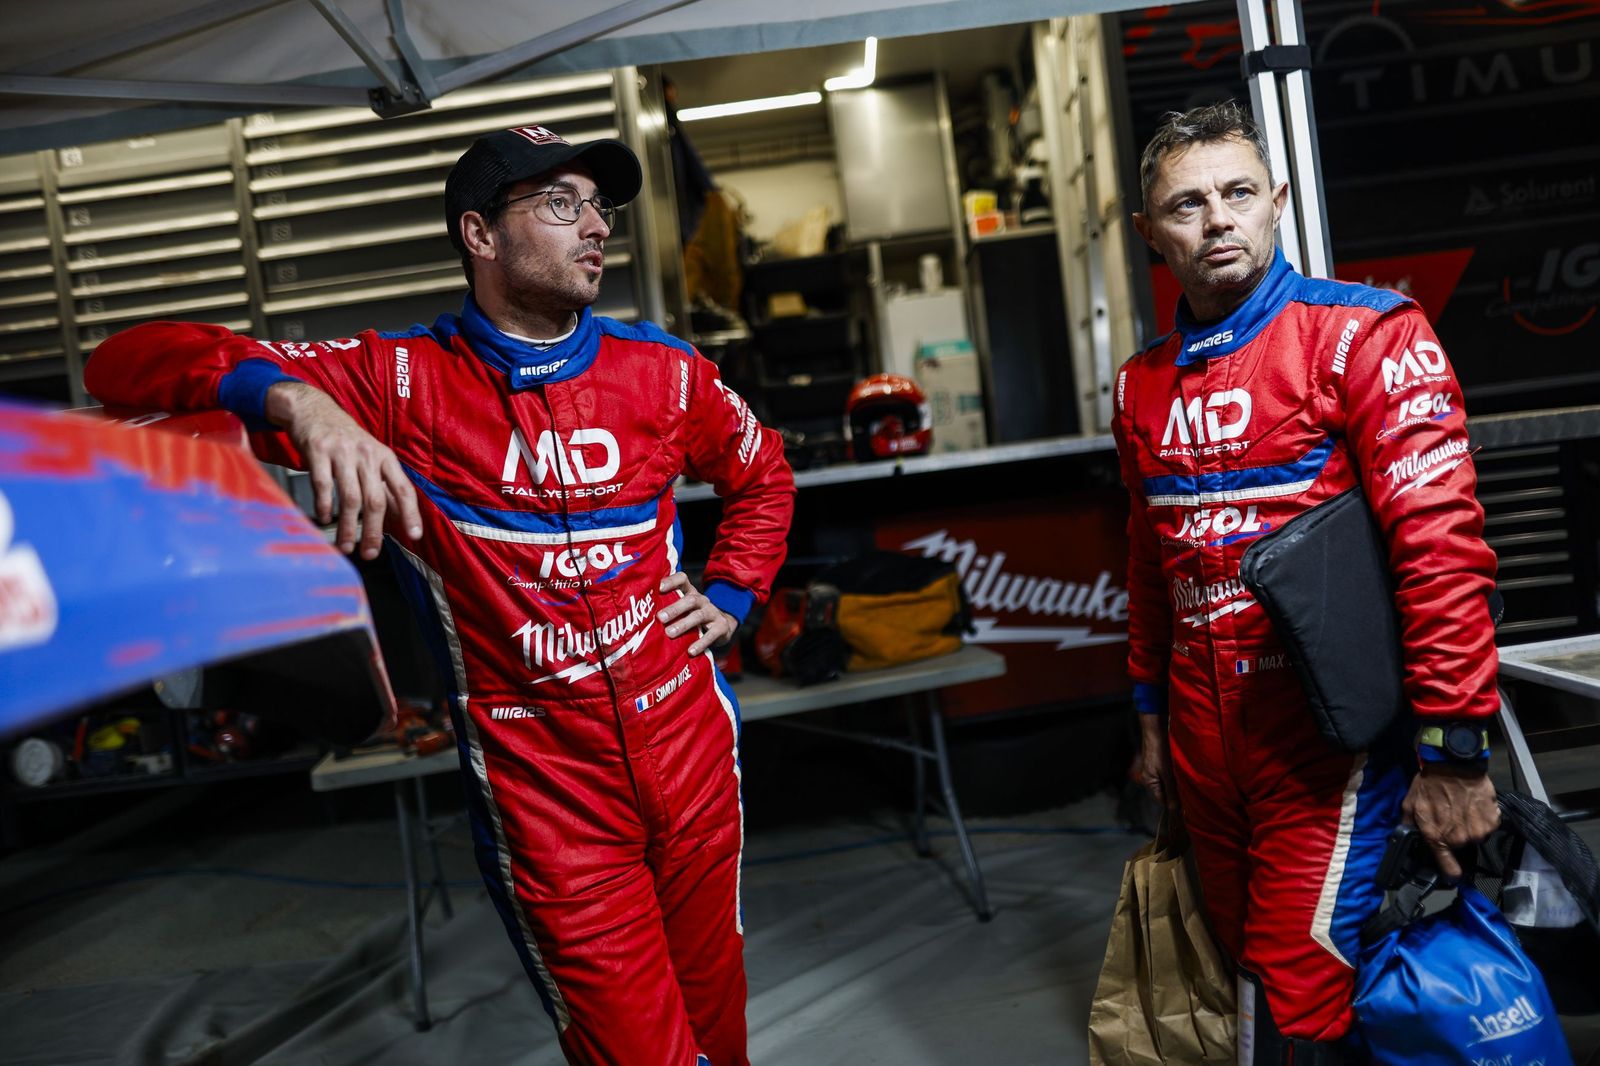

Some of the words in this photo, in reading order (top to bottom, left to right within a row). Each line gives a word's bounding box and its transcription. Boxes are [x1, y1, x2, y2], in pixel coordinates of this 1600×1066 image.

[1381, 341, 1446, 392] MD
[1161, 387, 1253, 446] MD
[1398, 392, 1452, 423] IGOL
[501, 427, 621, 486] MD
[1204, 441, 1250, 455] SPORT
[1383, 438, 1468, 490] Milwaukee
[574, 483, 624, 498] SPORT
[1175, 505, 1261, 539] IGOL
[539, 541, 633, 578] IGOL
[510, 590, 655, 670] Milwaukee
[1258, 654, 1286, 671] MAX
[655, 677, 677, 702] SIMON
